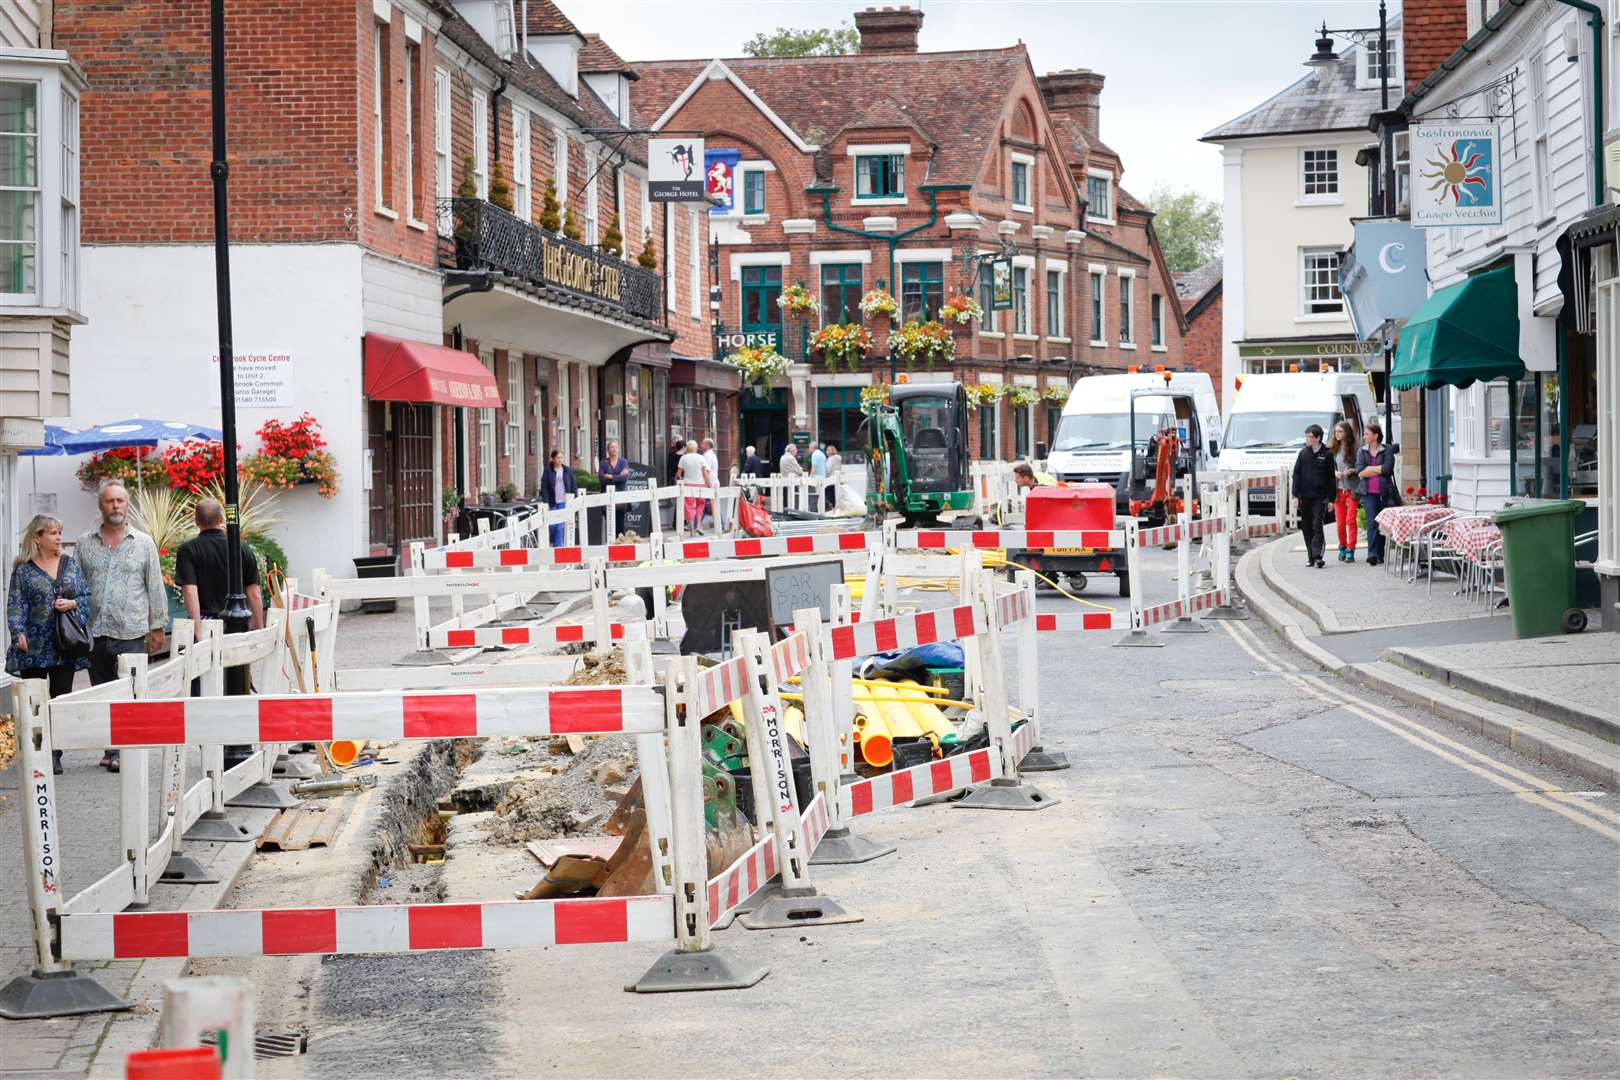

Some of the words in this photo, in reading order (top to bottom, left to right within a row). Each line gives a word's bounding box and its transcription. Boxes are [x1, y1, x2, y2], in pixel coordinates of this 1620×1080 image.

[1416, 127, 1492, 138] Gastronomia
[1455, 208, 1496, 218] Vecchio
[716, 333, 777, 347] HORSE
[248, 354, 266, 363] Cycle
[268, 354, 290, 362] Centre
[774, 573, 812, 593] CAR
[777, 592, 825, 610] PARK
[766, 718, 790, 800] MORRISON
[36, 784, 54, 878] MORRISON
